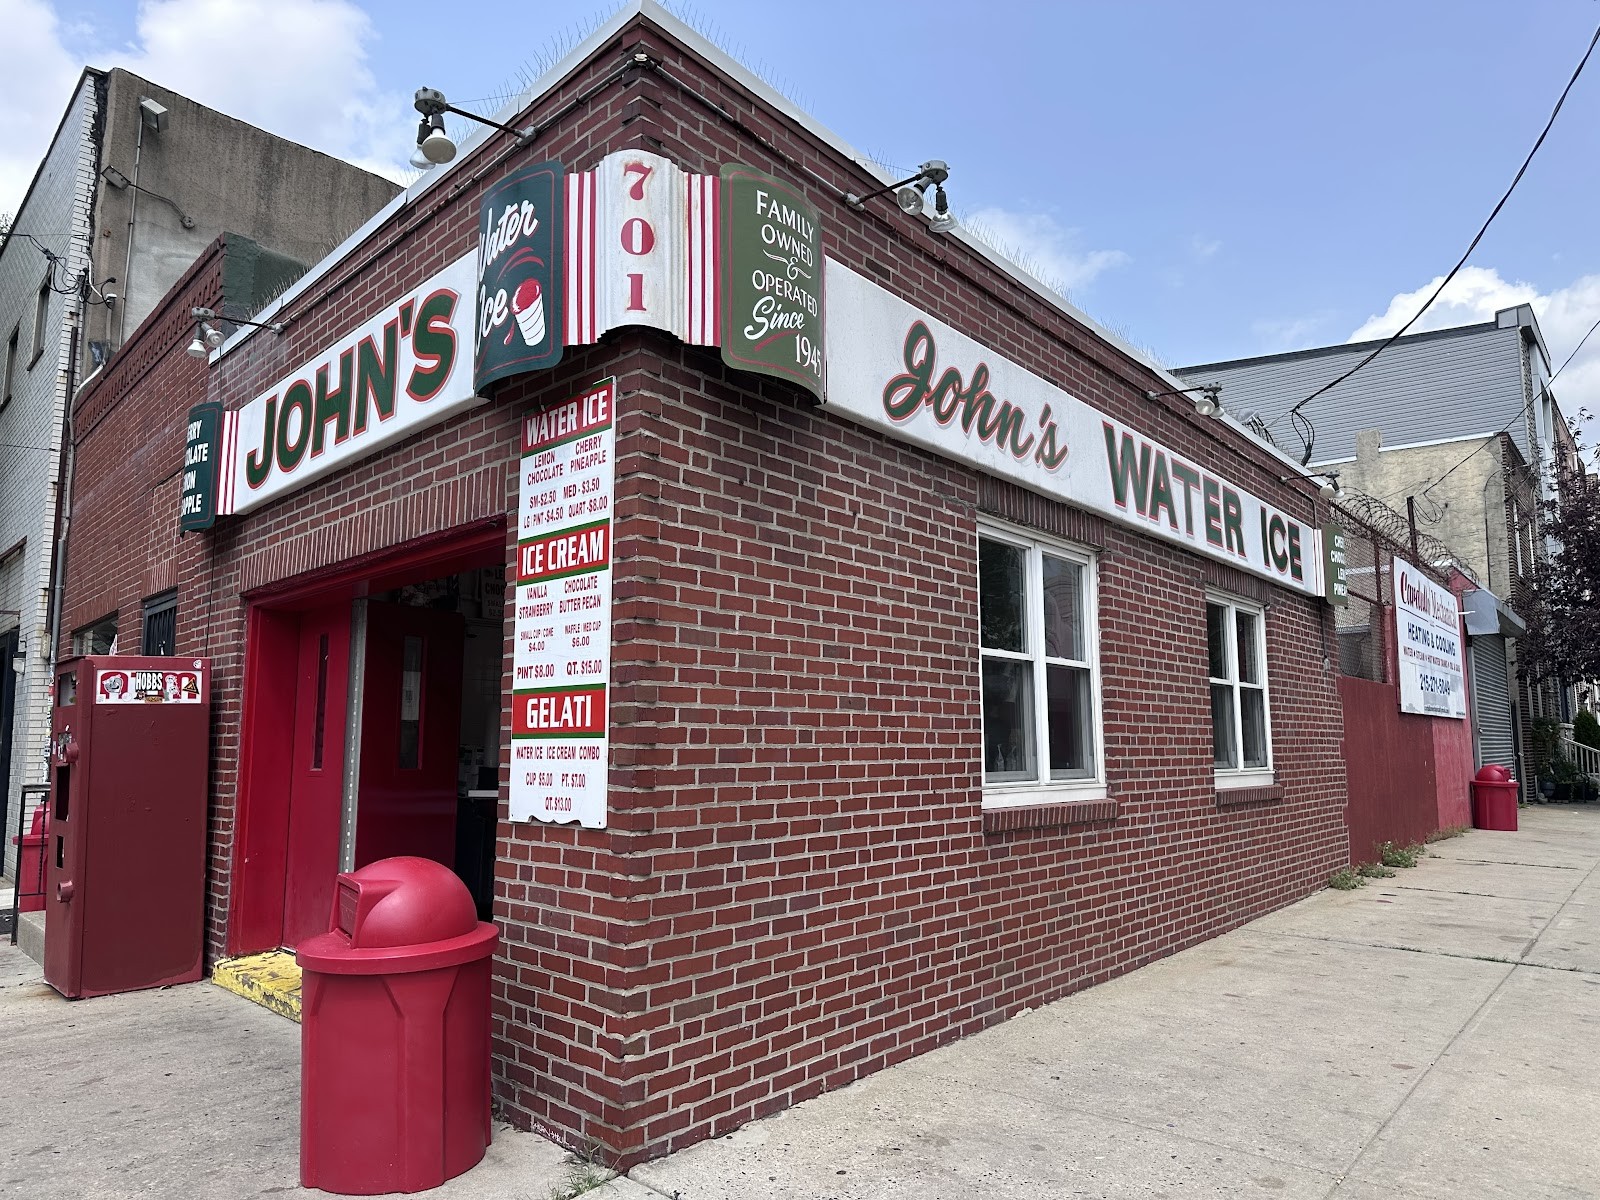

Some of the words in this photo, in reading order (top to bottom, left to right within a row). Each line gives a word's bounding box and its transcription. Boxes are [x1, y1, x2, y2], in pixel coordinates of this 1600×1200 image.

[756, 189, 815, 244] FAMILY
[761, 224, 814, 268] OWNED
[752, 270, 818, 318] OPERATED
[744, 296, 806, 340] Since
[245, 288, 460, 490] JOHN'S
[526, 401, 578, 447] WATER
[582, 390, 608, 428] ICE
[527, 464, 563, 486] CHOCOLATE
[570, 450, 607, 473] PINEAPPLE
[534, 451, 556, 469] LEMON
[575, 435, 603, 455] CHERRY
[881, 319, 1068, 471] John's
[1102, 420, 1249, 559] WATER
[1259, 506, 1304, 584] ICE
[563, 484, 577, 499] MED
[533, 511, 544, 526] PINT
[568, 501, 586, 518] QUART
[521, 542, 544, 576] ICE
[547, 529, 604, 572] CREAM
[526, 585, 548, 600] VANILLA
[564, 575, 598, 593] CHOCOLATE
[519, 602, 554, 619] STRAWBERRY
[559, 597, 580, 613] BUTTER
[582, 594, 601, 610] PECAN
[520, 631, 533, 640] SMALL
[543, 627, 554, 638] CONE
[564, 623, 581, 635] WAFFLE
[528, 640, 545, 652] $4.00
[571, 635, 590, 648] $6.00
[1407, 622, 1430, 647] HEATING
[1435, 634, 1456, 657] COOLING
[135, 672, 163, 691] HOBBS
[517, 665, 533, 680] PINT
[534, 663, 554, 679] $8.00
[566, 661, 579, 676] QT.
[581, 659, 602, 675] $15.00
[526, 694, 592, 729] GELATI
[516, 746, 533, 759] WATER
[534, 746, 543, 759] ICE
[546, 746, 555, 759] ICE
[556, 746, 576, 759] CREAM
[579, 746, 600, 760] COMBO
[525, 772, 537, 786] CUP
[539, 772, 553, 786] $5.00
[561, 773, 570, 787] PT.
[571, 773, 586, 788] $7.00
[545, 796, 554, 811] QT.
[554, 796, 572, 811] $13.00
